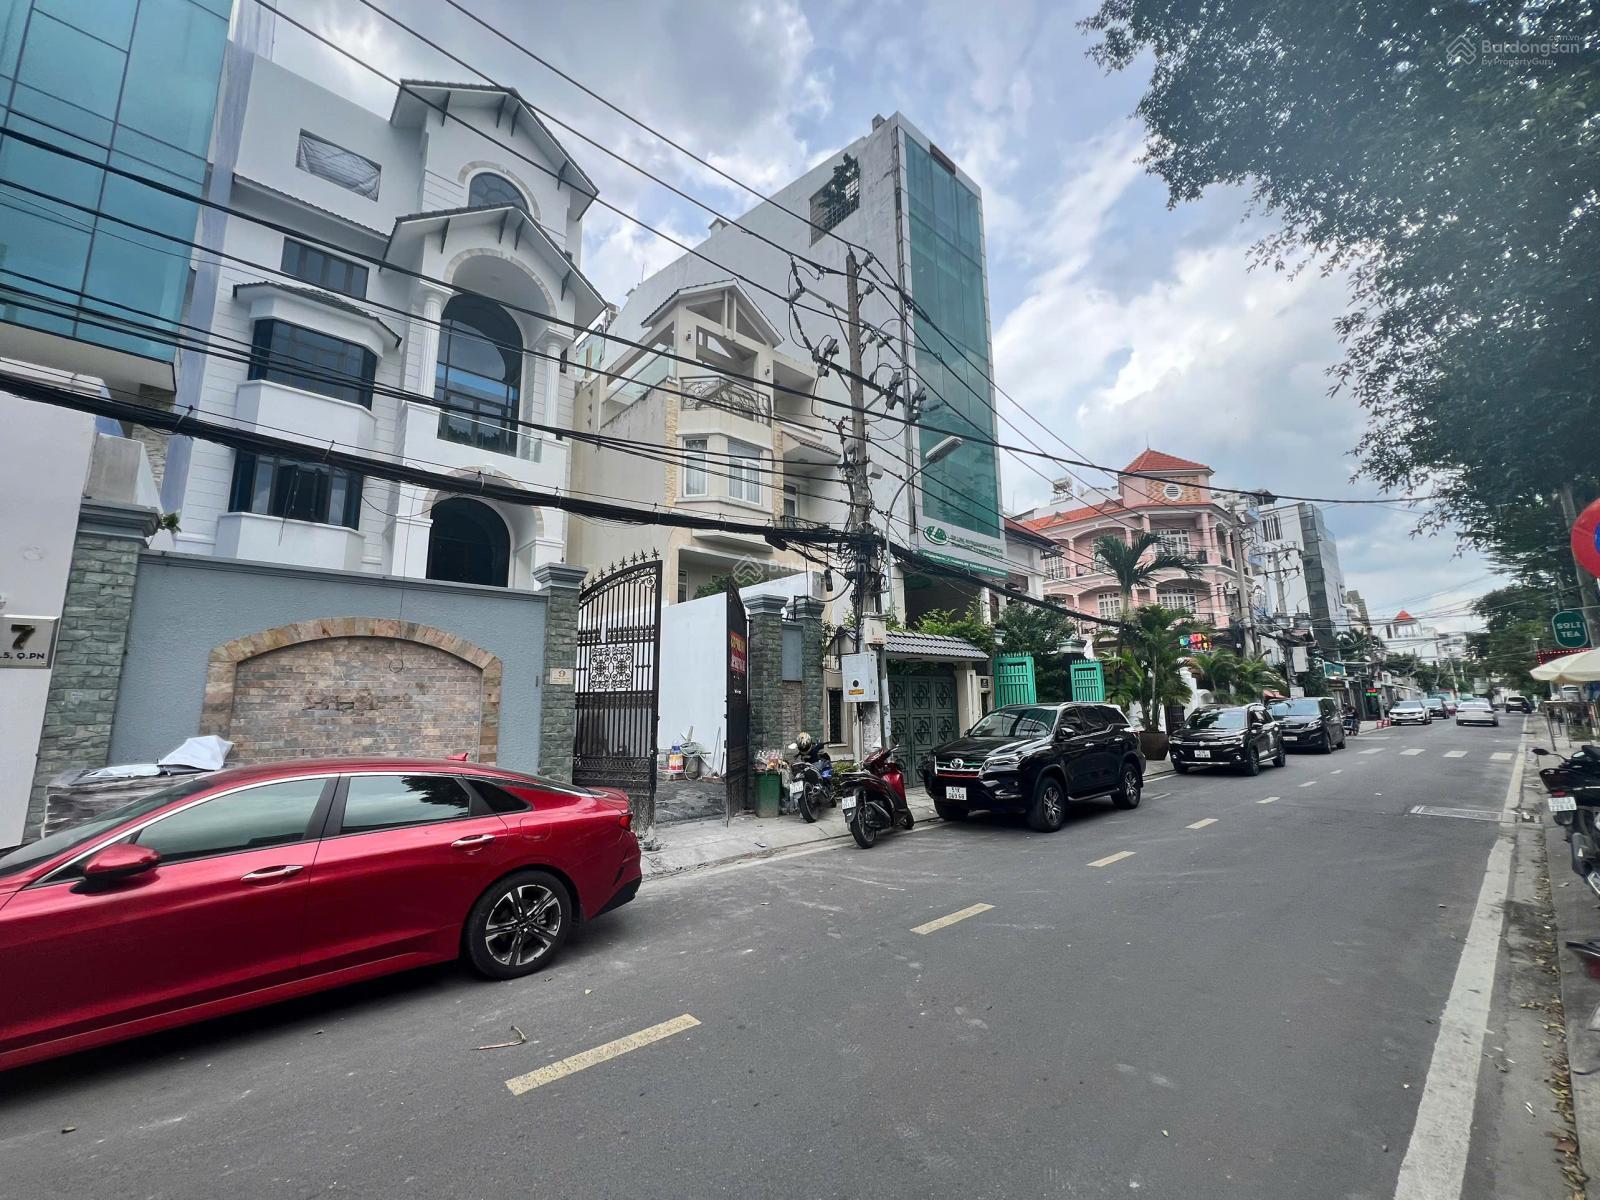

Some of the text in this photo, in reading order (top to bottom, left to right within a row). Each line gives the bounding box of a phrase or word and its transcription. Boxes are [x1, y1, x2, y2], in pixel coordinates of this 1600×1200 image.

[11, 624, 36, 650] 7
[17, 652, 45, 660] Q.PN
[558, 669, 567, 678] 9
